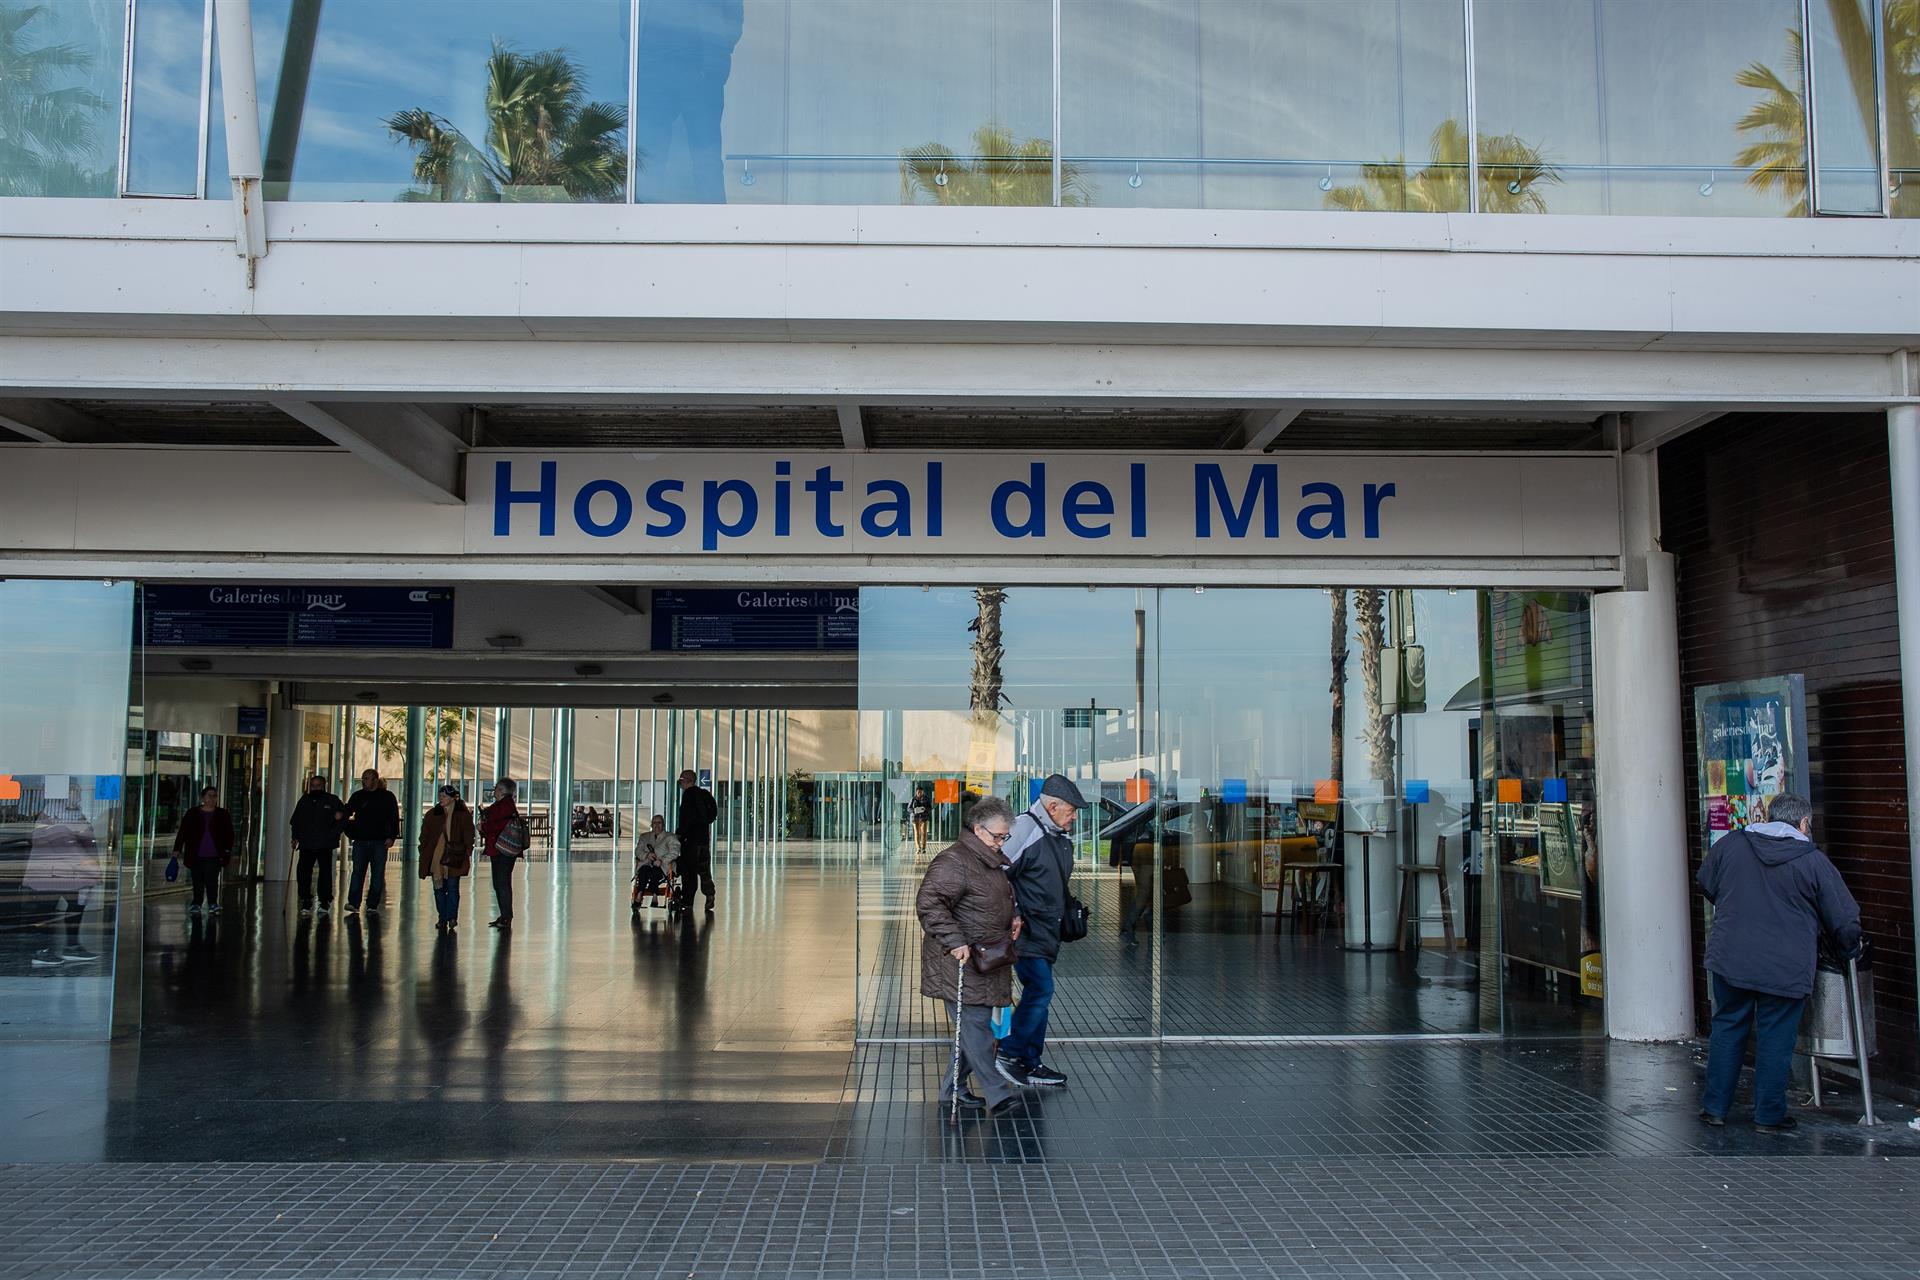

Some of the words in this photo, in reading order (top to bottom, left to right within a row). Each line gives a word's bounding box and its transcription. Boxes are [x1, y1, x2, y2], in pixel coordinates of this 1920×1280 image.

[493, 462, 942, 551] Hospital
[991, 464, 1147, 538] del
[1195, 464, 1395, 538] Mar
